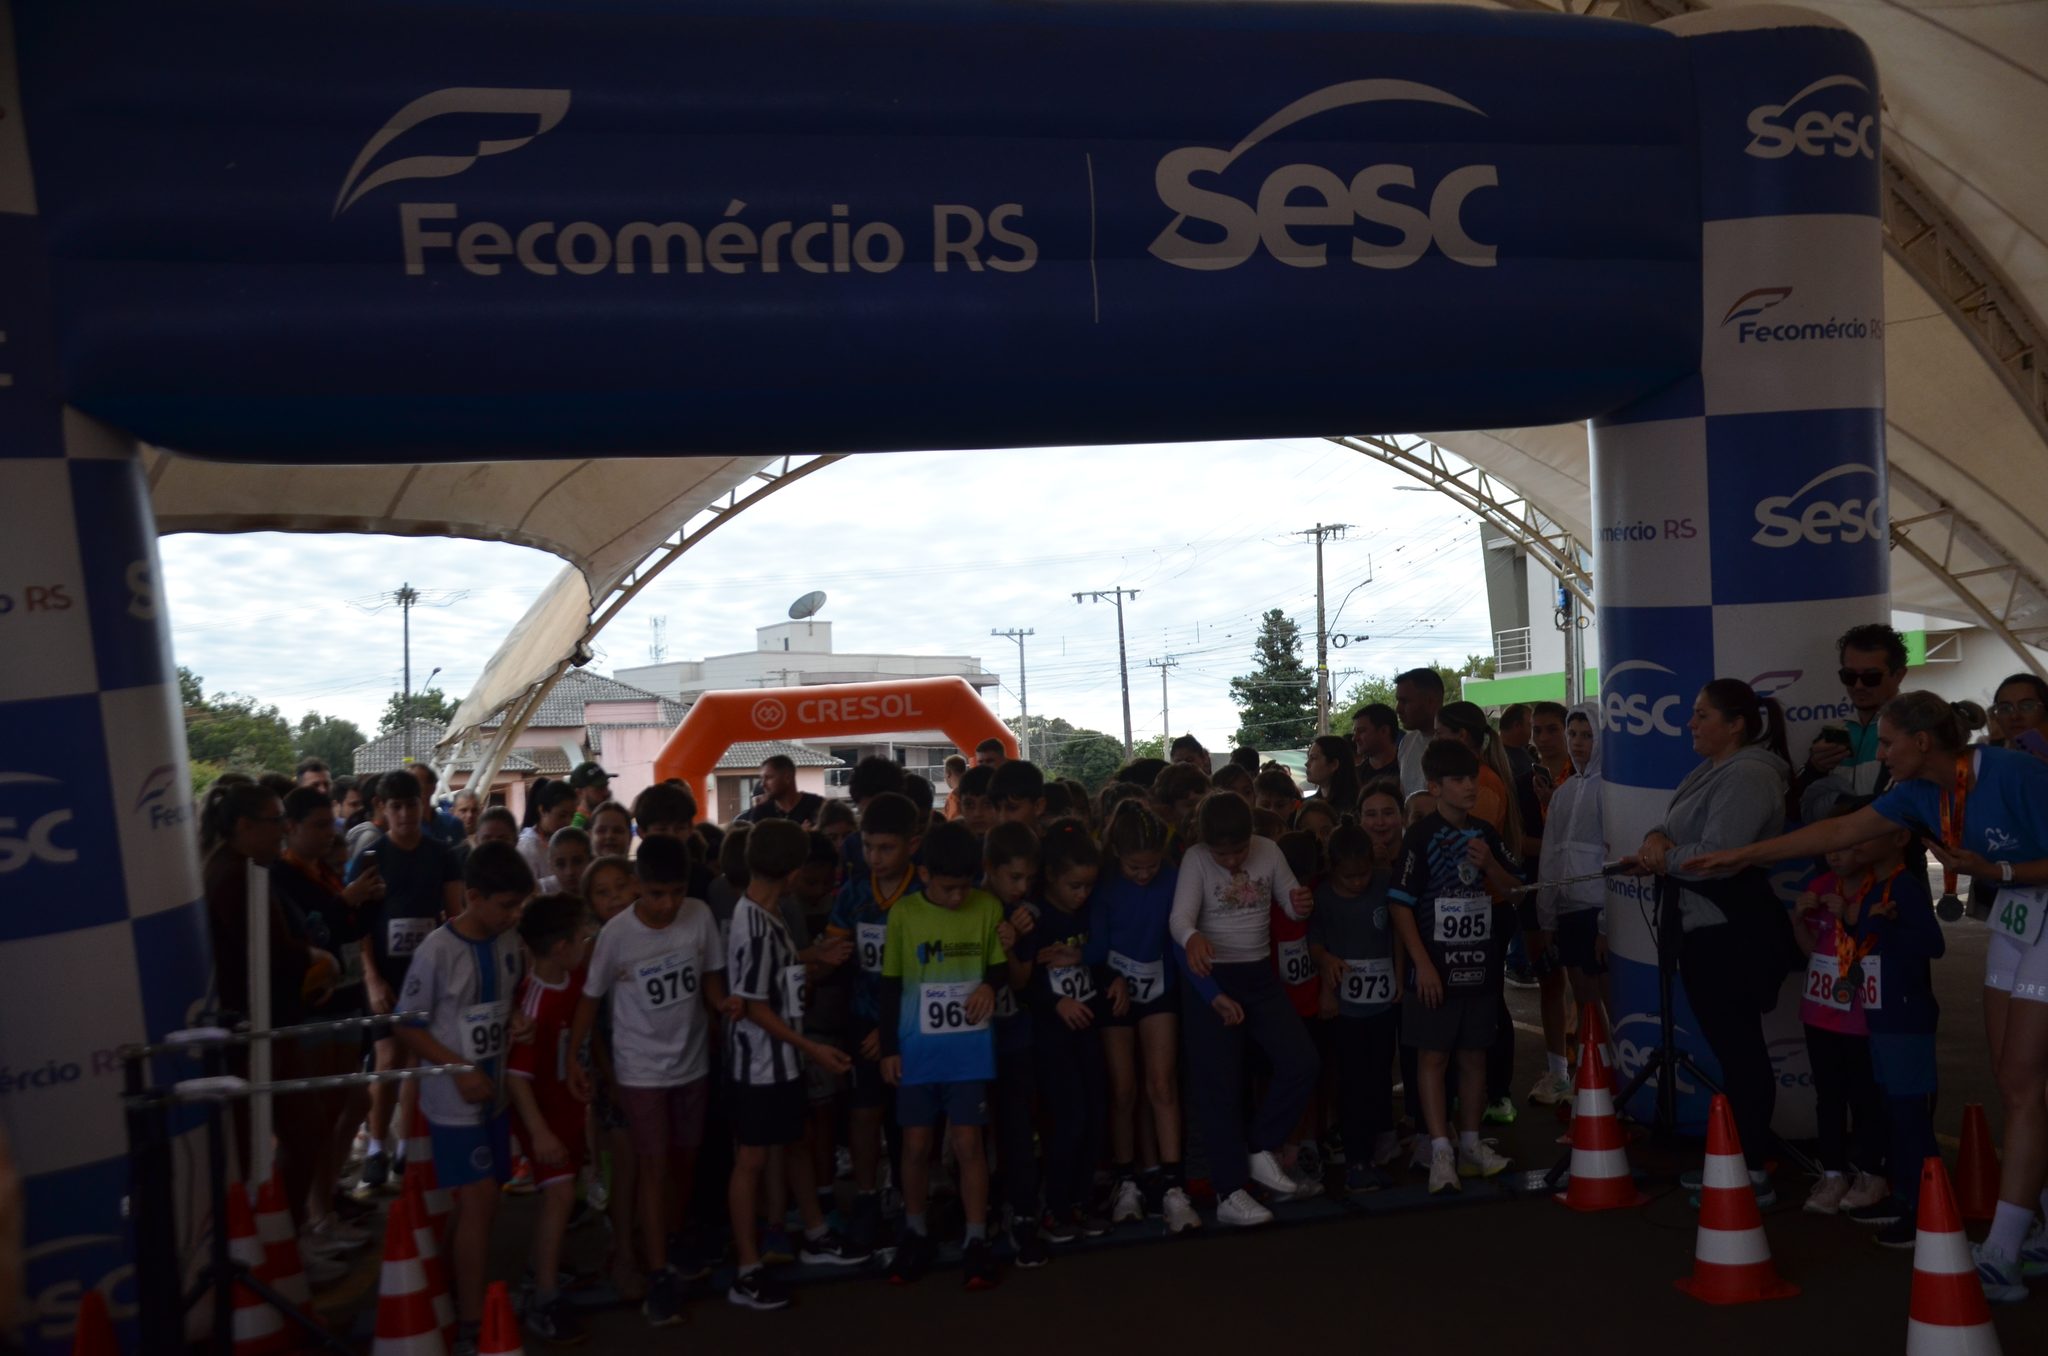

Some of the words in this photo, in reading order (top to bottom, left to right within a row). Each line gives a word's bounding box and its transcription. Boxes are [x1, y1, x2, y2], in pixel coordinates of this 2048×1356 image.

[1744, 103, 1875, 161] Sesc
[1147, 146, 1500, 271] Sesc
[399, 199, 905, 277] Fecomércio
[932, 203, 1039, 273] RS
[1738, 317, 1867, 344] Fecomércio
[1599, 520, 1657, 542] mércio
[1663, 518, 1697, 540] RS
[1751, 495, 1883, 549] Sesc
[25, 584, 73, 612] RS
[797, 693, 923, 723] CRESOL
[1601, 691, 1682, 737] esc
[1443, 913, 1485, 938] 985
[2000, 901, 2028, 935] 48
[1444, 950, 1486, 965] KTO
[646, 966, 697, 1005] 976
[1348, 974, 1390, 999] 973
[1809, 970, 1833, 1000] 28
[472, 1023, 507, 1055] 99
